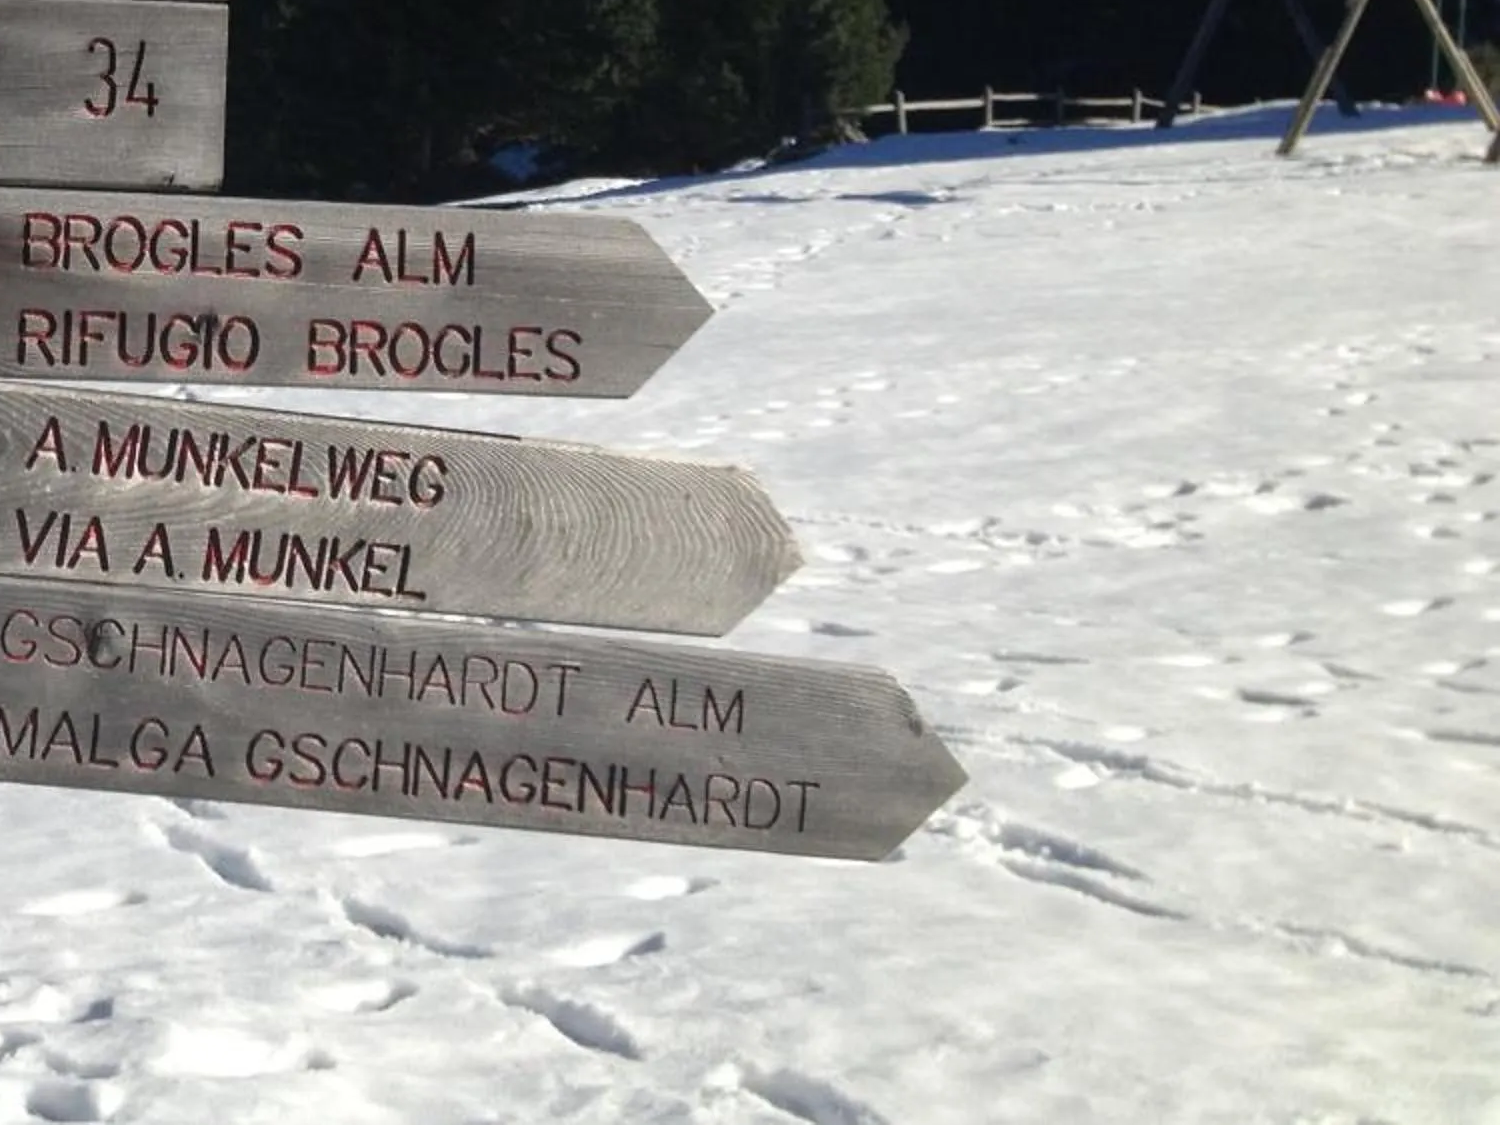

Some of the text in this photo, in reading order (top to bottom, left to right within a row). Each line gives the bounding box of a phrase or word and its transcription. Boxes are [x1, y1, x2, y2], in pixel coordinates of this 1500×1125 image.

[83, 37, 159, 118] 34
[21, 212, 476, 287] BROGLES ALM
[16, 308, 261, 372] RIFUGIO
[98, 421, 447, 509] MUNKELWEG
[15, 508, 110, 574] VIA
[201, 528, 427, 602] MUNKEL
[0, 607, 746, 736] GSCHNAGENHARDT ALM
[243, 728, 822, 834] GSCHNAGENHARDT
